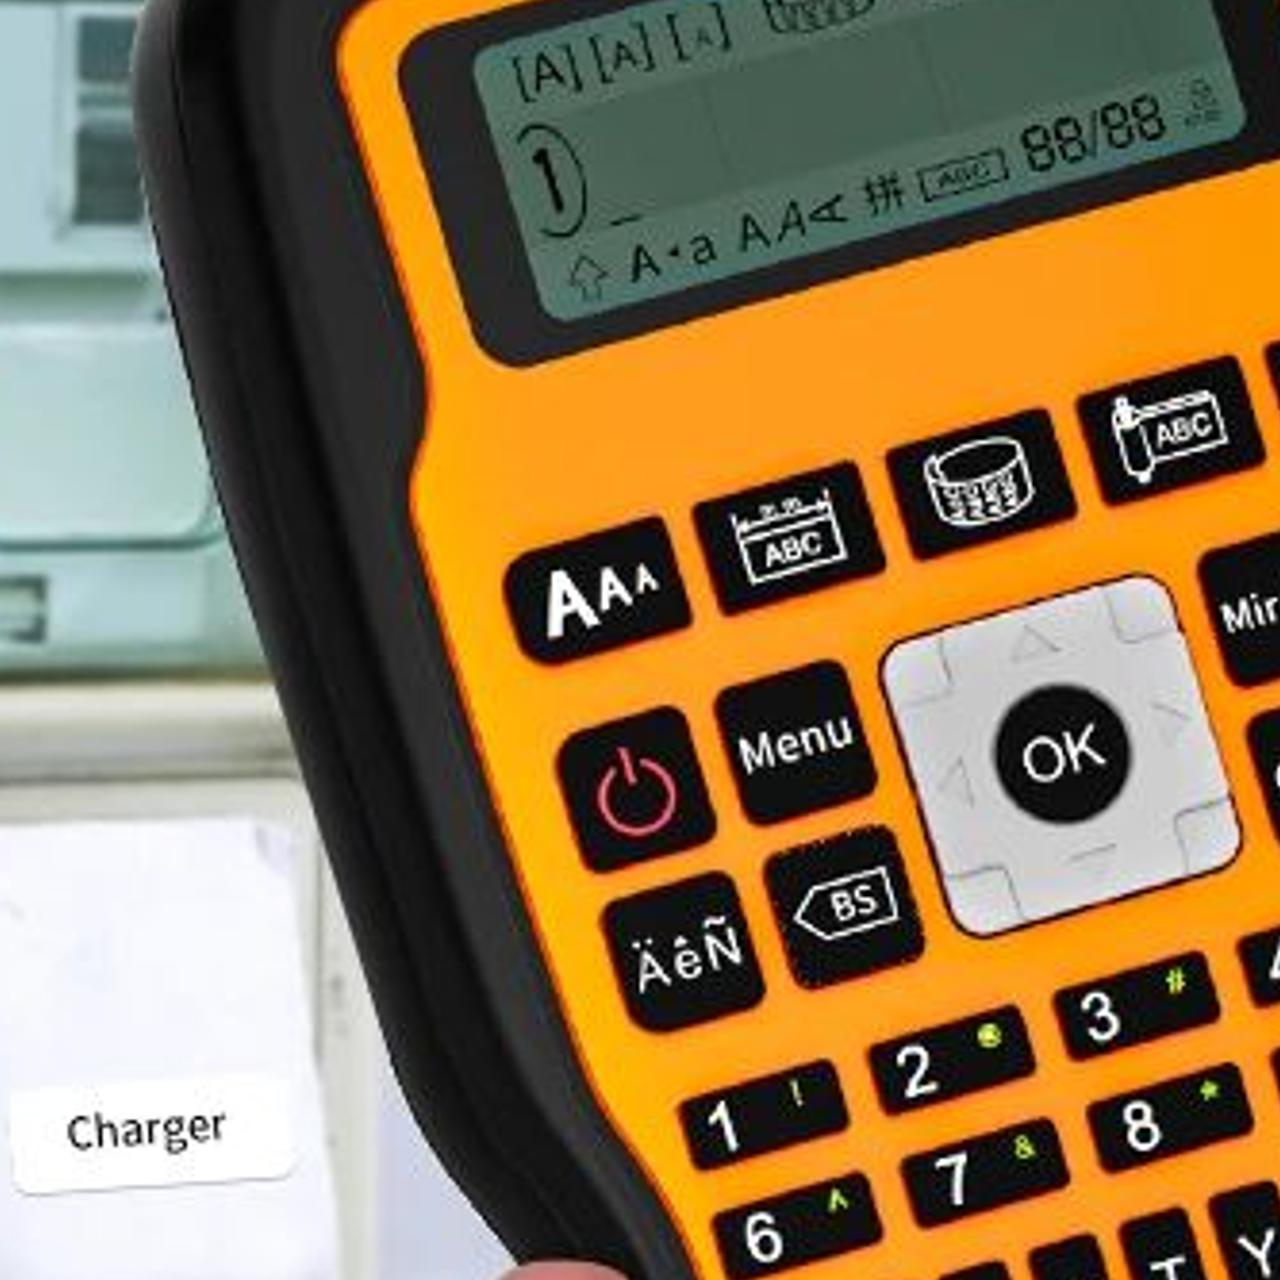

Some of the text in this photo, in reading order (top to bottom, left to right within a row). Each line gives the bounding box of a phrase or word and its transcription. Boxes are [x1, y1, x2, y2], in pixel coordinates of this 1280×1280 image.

[1020, 94, 1168, 173] 88/88
[1154, 412, 1214, 450] ABC
[762, 530, 824, 570] ABC
[737, 716, 854, 776] Menu
[1021, 728, 1108, 784] OK
[826, 880, 879, 923] BS
[630, 914, 743, 995] ÄêÑ
[1079, 990, 1122, 1043] 3
[895, 1043, 939, 1100] 2
[66, 1111, 227, 1156] Charger
[707, 1099, 740, 1153] 1
[1121, 1099, 1163, 1153] 8
[933, 1150, 969, 1207] 7
[744, 1210, 784, 1264] 6
[1236, 1226, 1276, 1279] Y
